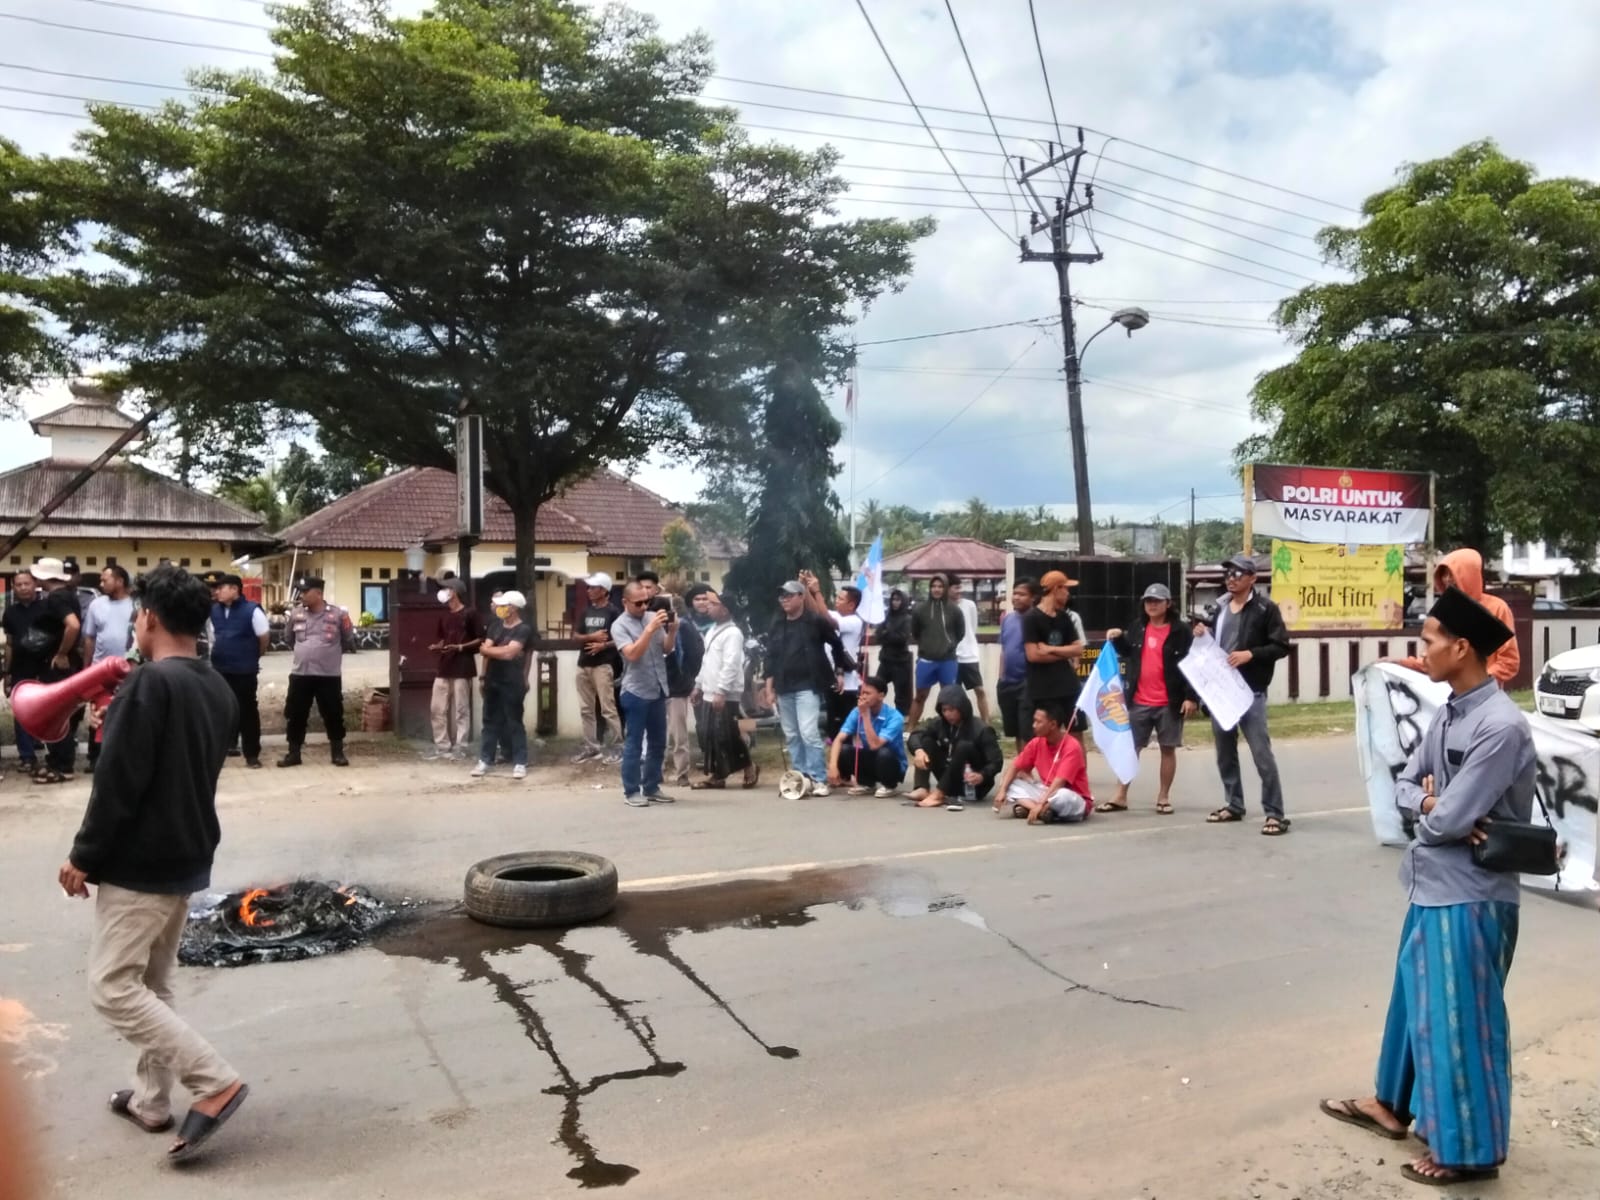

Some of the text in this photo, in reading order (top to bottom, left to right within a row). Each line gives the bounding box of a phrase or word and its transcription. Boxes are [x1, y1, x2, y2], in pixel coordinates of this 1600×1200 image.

[1282, 485, 1403, 506] POLRI UNTUK
[1284, 507, 1402, 524] MASYARAKAT
